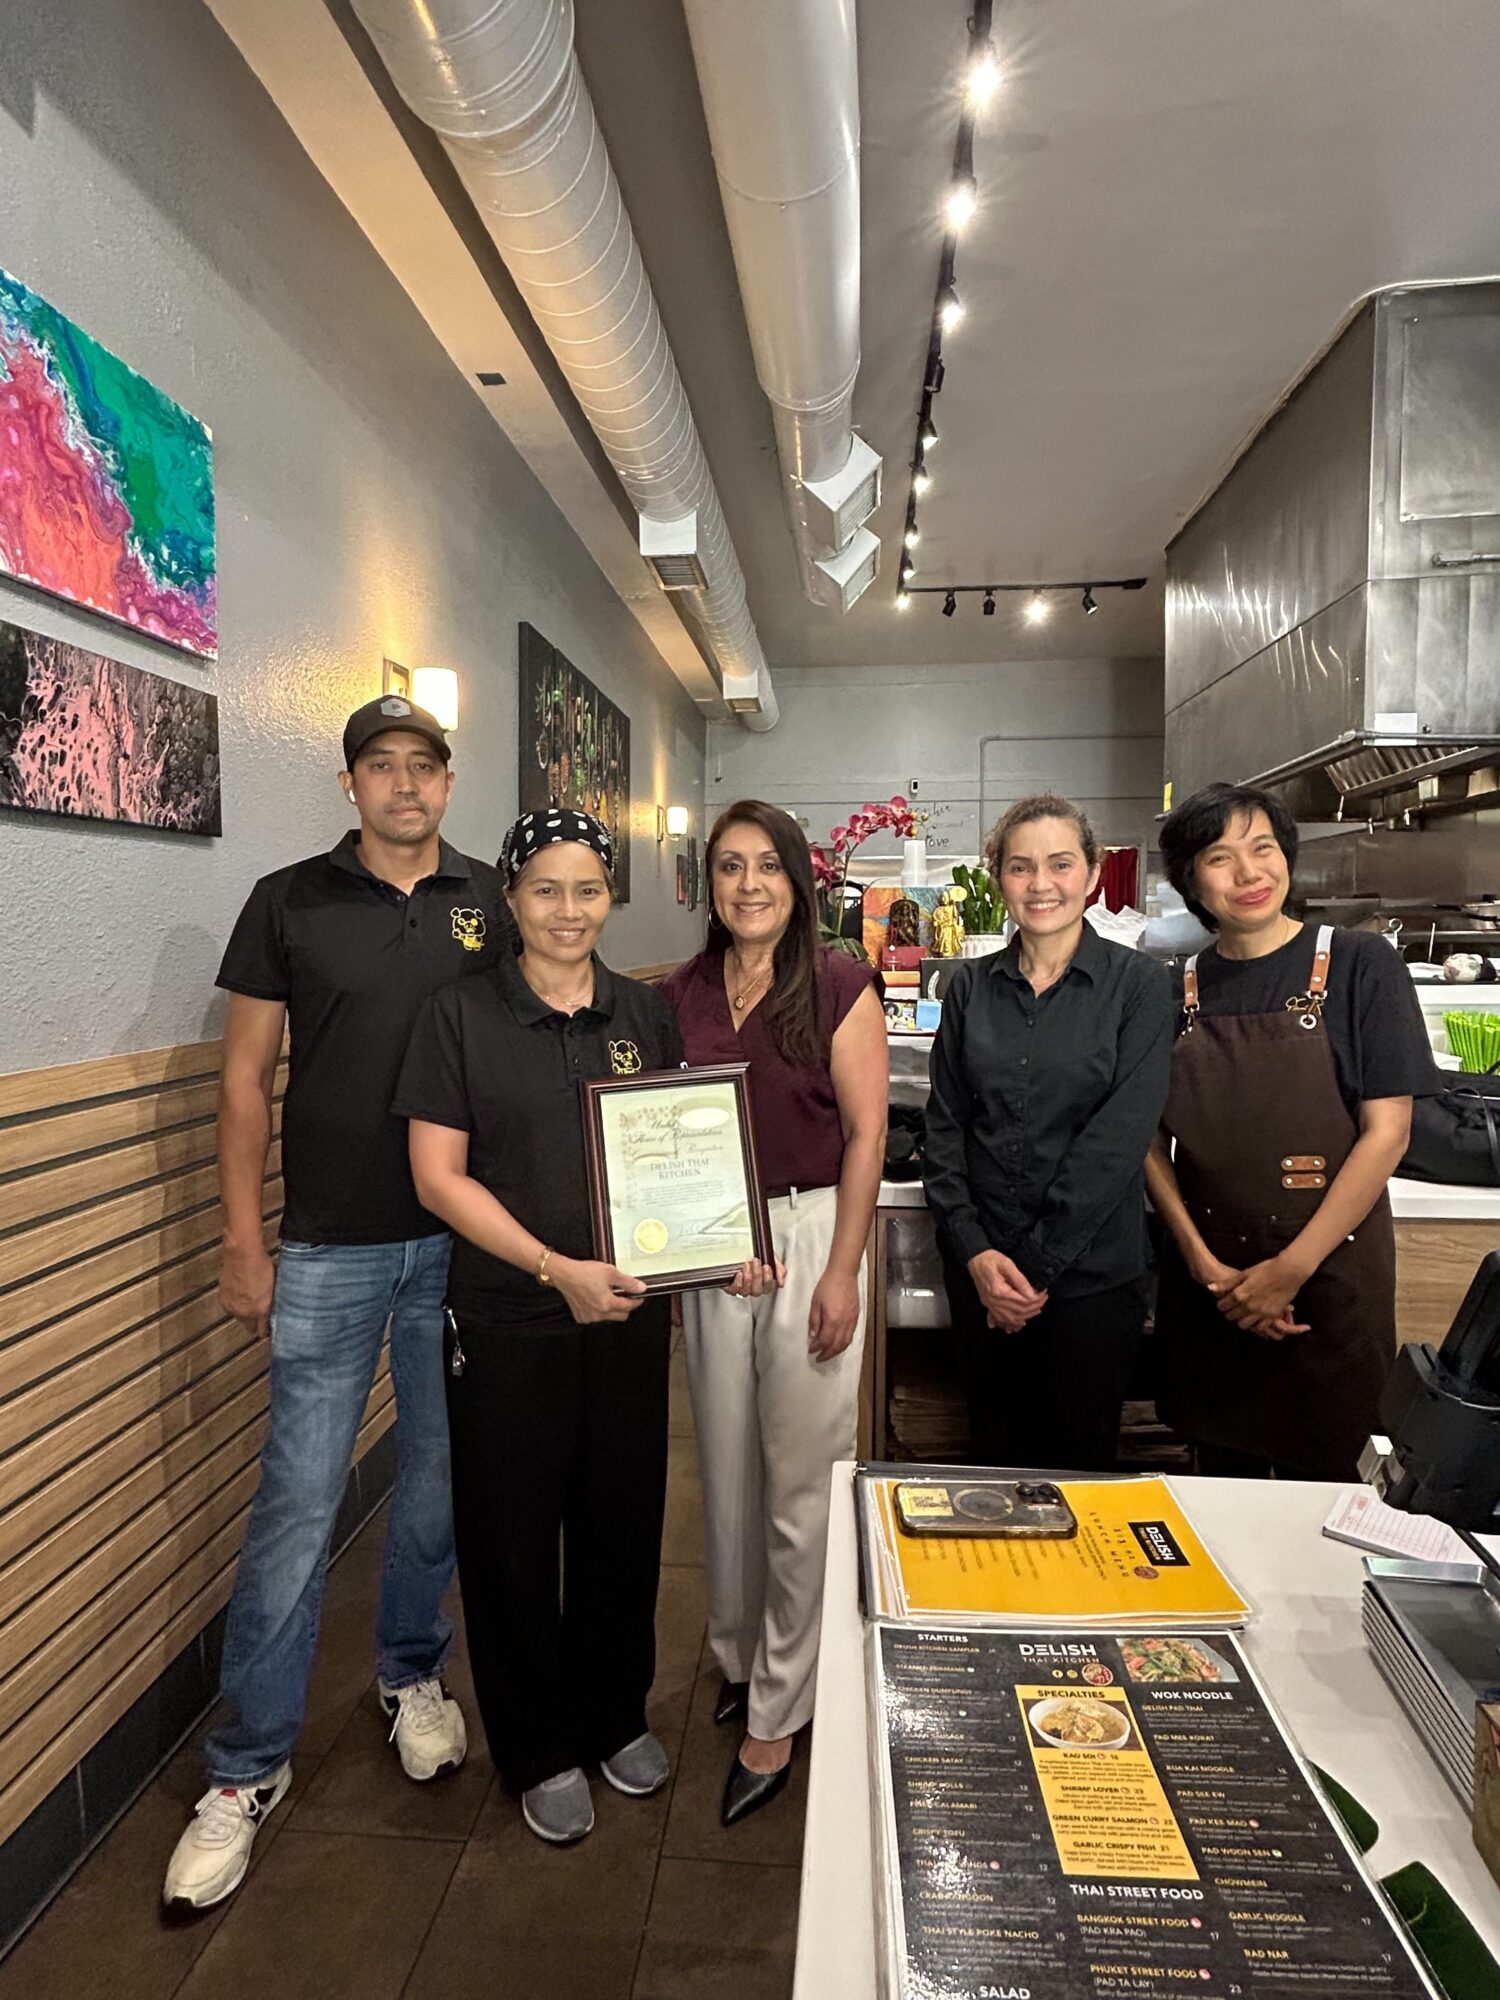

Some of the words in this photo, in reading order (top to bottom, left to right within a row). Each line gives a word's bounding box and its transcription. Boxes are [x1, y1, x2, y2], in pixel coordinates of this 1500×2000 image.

[650, 1161, 685, 1171] DELISH
[687, 1158, 710, 1168] THAI
[658, 1169, 701, 1180] KITCHEN
[1145, 1526, 1176, 1561] DELISH
[918, 1633, 968, 1643] STARTERS
[1018, 1643, 1097, 1656] DELISH
[1023, 1656, 1048, 1664] THAI
[1053, 1656, 1101, 1664] KITCHEN
[1037, 1689, 1105, 1699] SPECIALTIES
[1151, 1691, 1181, 1700] WOK
[1183, 1691, 1234, 1700] NOODLE
[904, 1756, 940, 1764] CHICKEN
[941, 1757, 964, 1765] SATAY
[1061, 1785, 1091, 1793] SHRIMP
[1093, 1786, 1120, 1794] LOVER
[934, 1801, 978, 1810] CALAMARI
[1052, 1814, 1081, 1822] GREEN
[1083, 1815, 1109, 1823] CURRY
[1111, 1816, 1148, 1825] SALMON
[1189, 1817, 1207, 1825] PAD
[912, 1827, 940, 1836] CRISPY
[1073, 1840, 1103, 1849] GARLIC
[1106, 1842, 1135, 1850] CRISPY
[1201, 1846, 1220, 1855] PAD
[1039, 1864, 1048, 1872] 12
[1070, 1883, 1104, 1896] THAI
[1107, 1885, 1157, 1898] STREET
[1161, 1887, 1205, 1900] FOOD
[1046, 1896, 1056, 1905] 12
[1077, 1914, 1124, 1925] BANGKOK
[1126, 1916, 1159, 1926] STREET
[1161, 1918, 1190, 1928] FOOD
[1229, 1911, 1263, 1921] GARLIC
[1264, 1913, 1306, 1923] NOODLE
[922, 1925, 945, 1935] THAI
[947, 1927, 975, 1937] STYLE
[976, 1928, 1002, 1938] POKE
[1004, 1930, 1040, 1940] NACHO
[1080, 1926, 1102, 1935] (PAD
[1103, 1927, 1124, 1936] KRA
[1210, 1932, 1220, 1940] 17
[1267, 1949, 1289, 1960] NAR
[1090, 1964, 1129, 1975] PHUKET
[1131, 1965, 1166, 1977] STREET
[1168, 1967, 1198, 1979] FOOD
[1093, 1976, 1117, 1987] (PAD
[1119, 1978, 1131, 1987] TA
[1132, 1979, 1155, 1989] LAY)
[979, 1985, 1031, 2000] SALAD
[1229, 1984, 1242, 1994] 23
